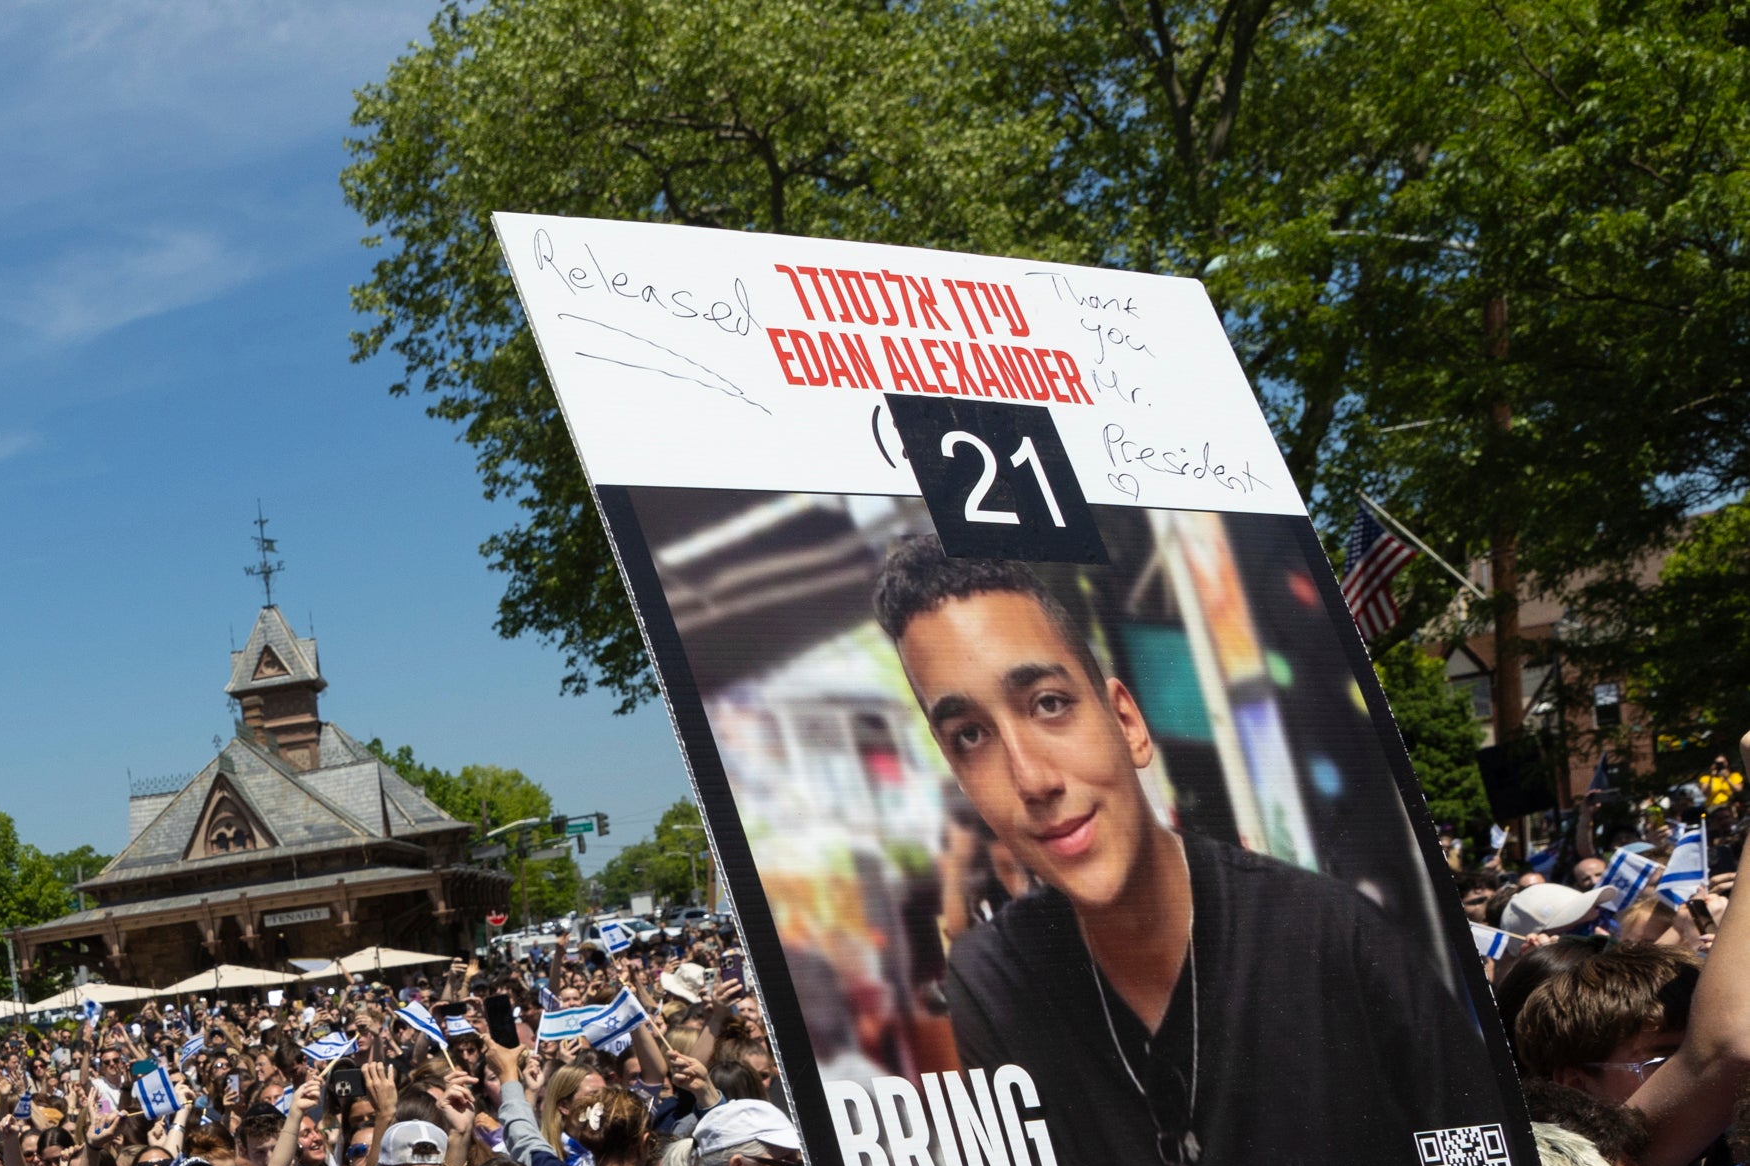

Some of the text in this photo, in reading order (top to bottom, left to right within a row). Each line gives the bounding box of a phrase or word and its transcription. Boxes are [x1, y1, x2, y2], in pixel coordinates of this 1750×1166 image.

[534, 228, 762, 336] Released
[774, 263, 1031, 340] עידן אלכסנדר
[1024, 271, 1141, 320] Thank
[766, 327, 1096, 406] EDAN ALEXANDER
[1080, 318, 1156, 365] you
[940, 430, 1067, 528] 21
[1102, 423, 1273, 494] President
[271, 909, 323, 924] TENAFLY
